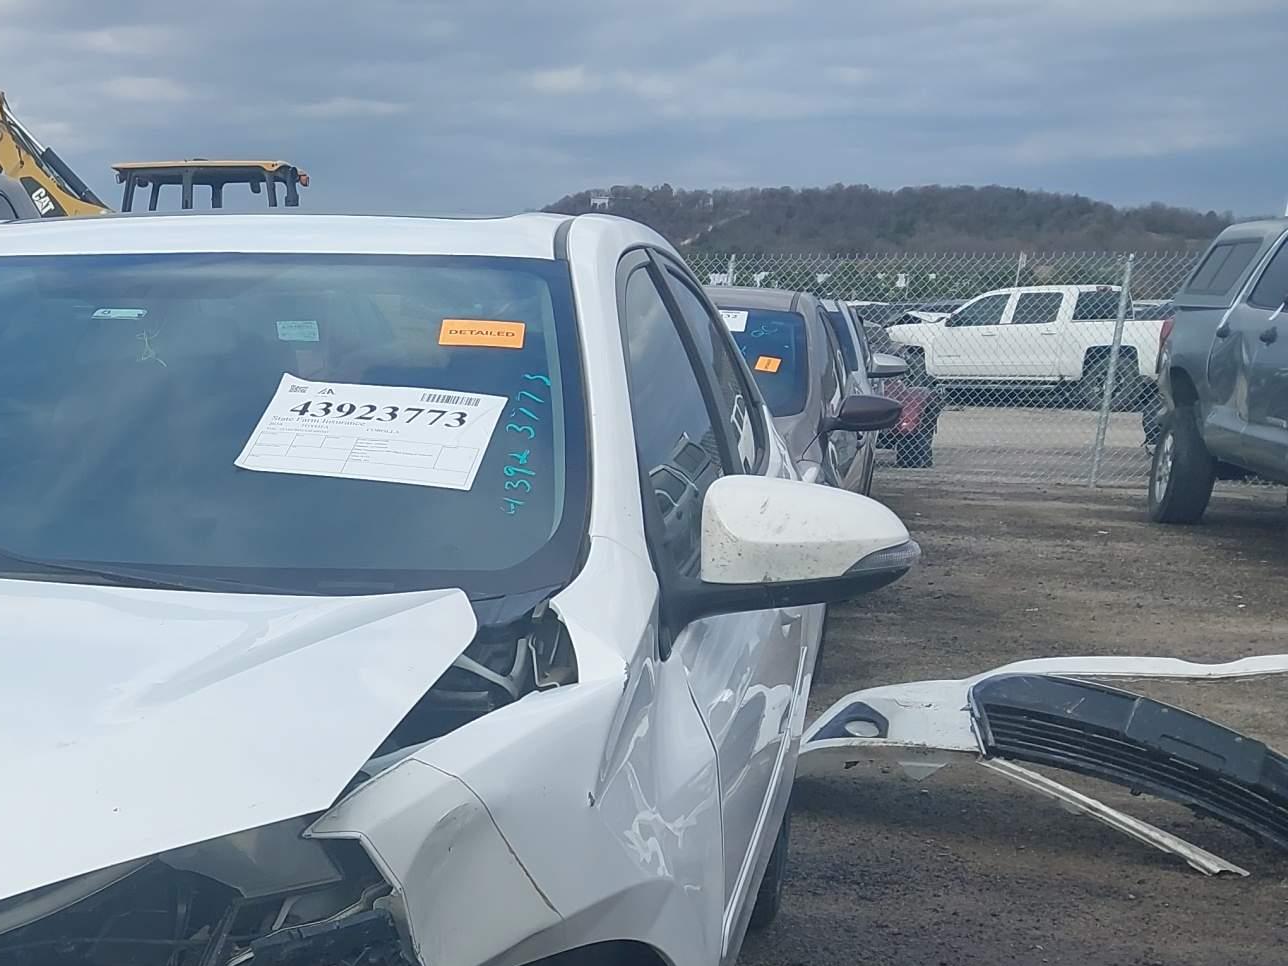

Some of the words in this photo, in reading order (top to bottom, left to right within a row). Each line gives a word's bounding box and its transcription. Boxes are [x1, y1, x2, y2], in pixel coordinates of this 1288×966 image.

[32, 187, 55, 215] CAT
[448, 328, 516, 338] DETAILED
[289, 400, 468, 429] 43923773
